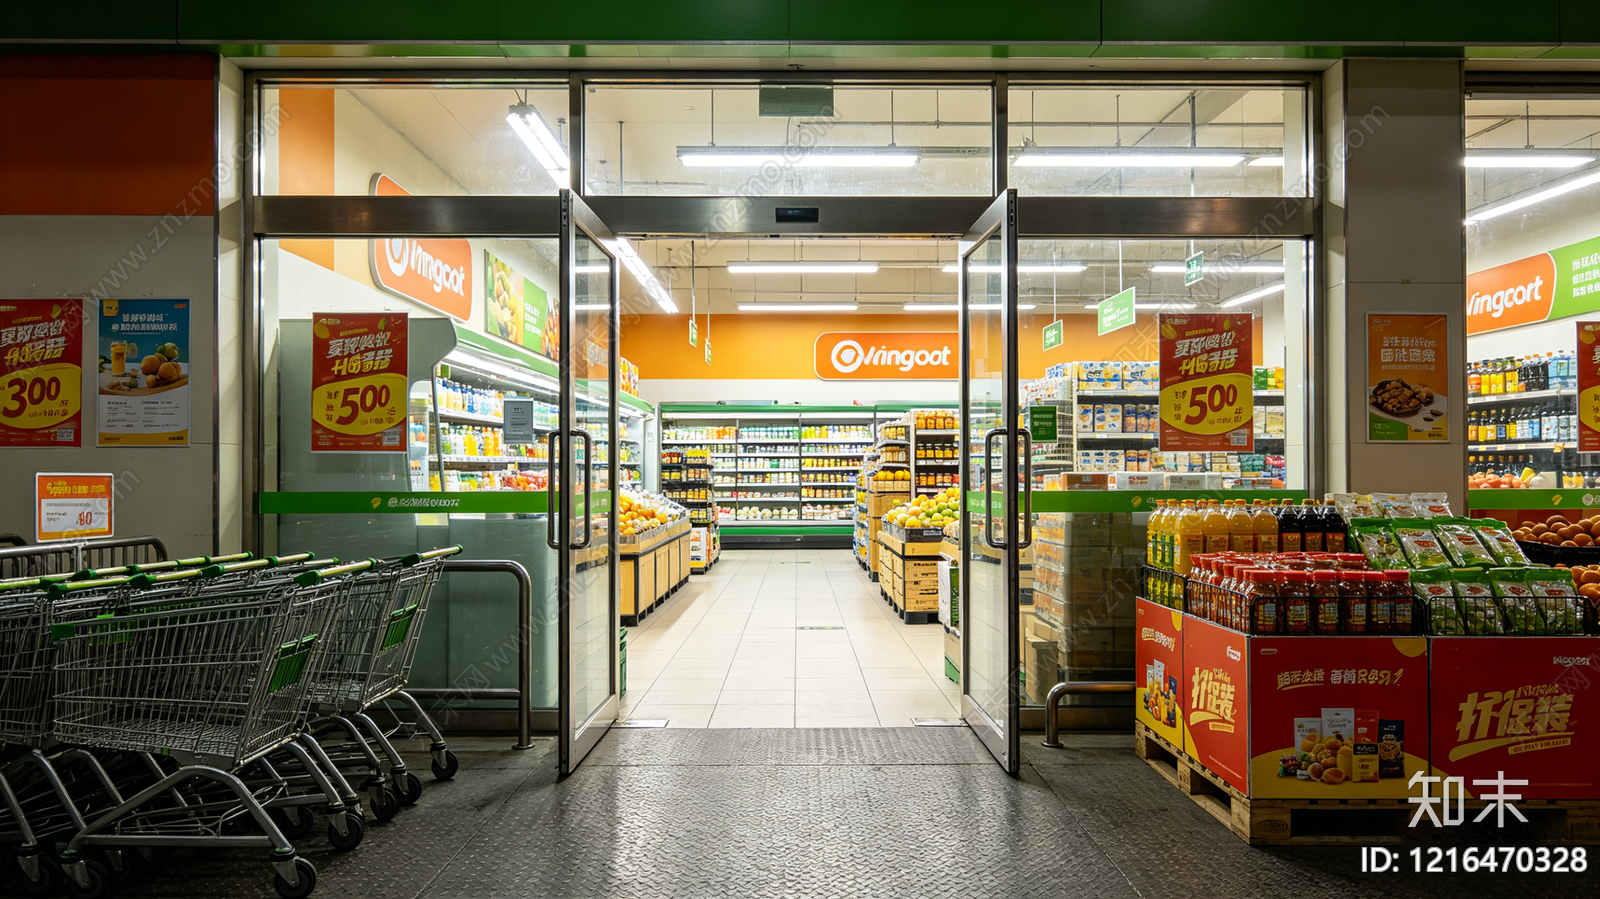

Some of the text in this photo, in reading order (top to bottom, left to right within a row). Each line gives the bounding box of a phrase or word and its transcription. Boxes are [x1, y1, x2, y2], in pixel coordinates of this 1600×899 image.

[2, 377, 61, 419] 300
[335, 384, 391, 426] 500
[1184, 383, 1238, 426] 500
